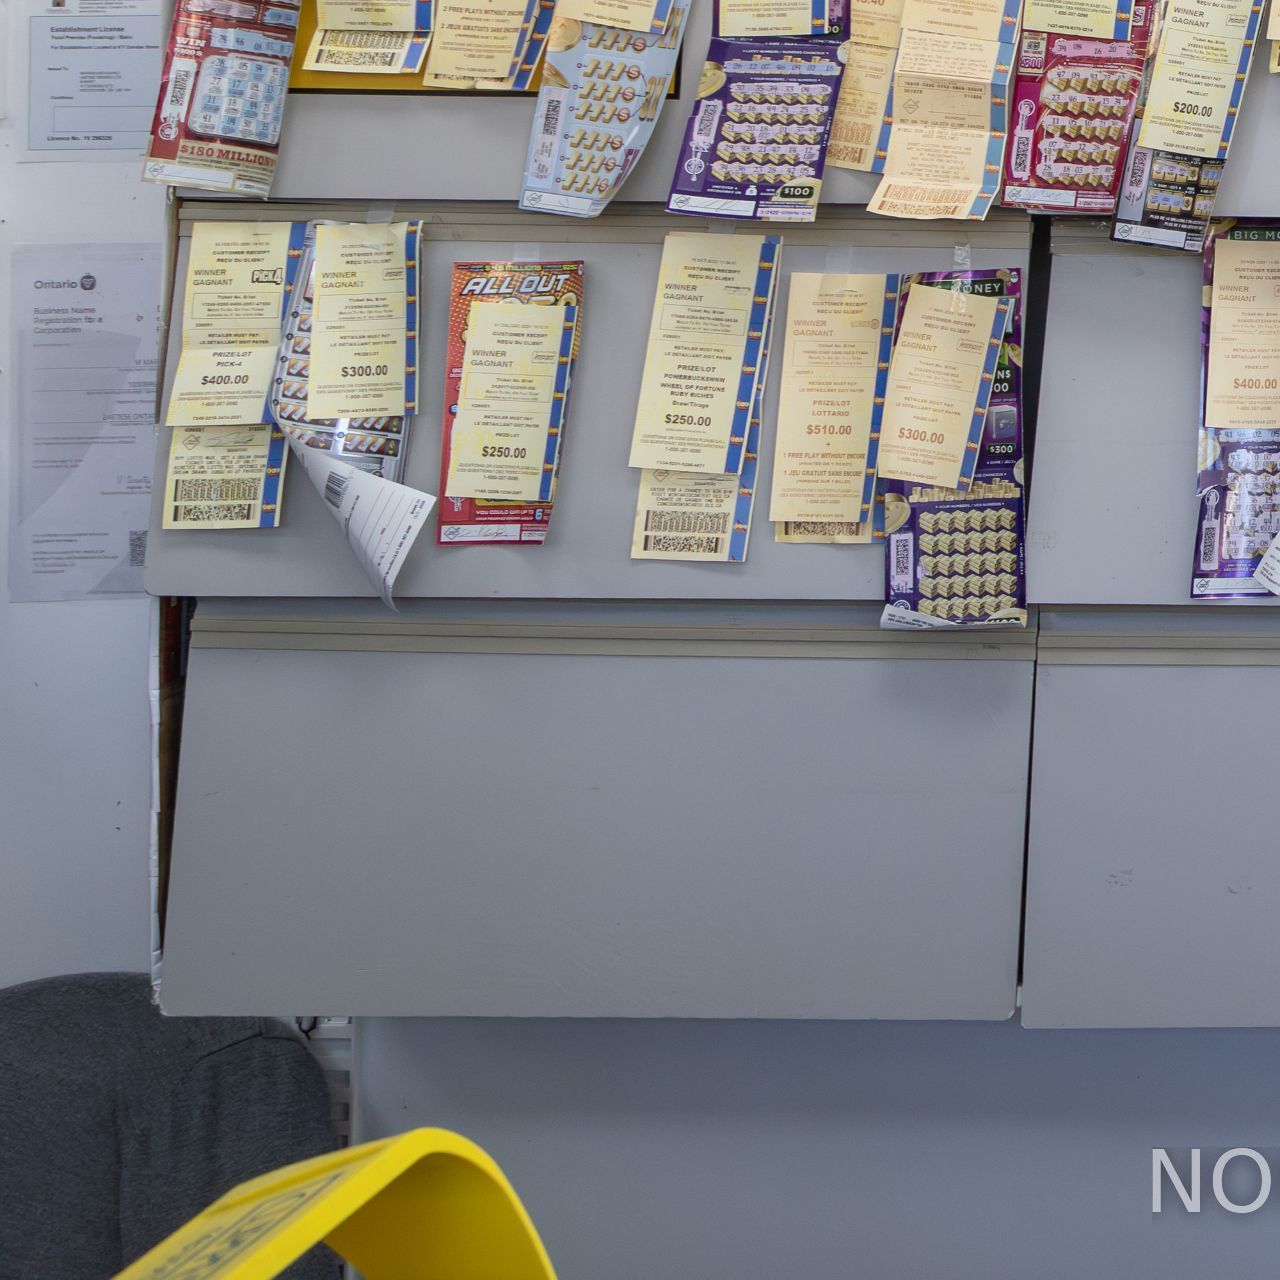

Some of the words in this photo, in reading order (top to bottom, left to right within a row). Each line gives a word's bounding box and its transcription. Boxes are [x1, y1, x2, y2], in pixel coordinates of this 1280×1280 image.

[1173, 102, 1213, 117] $200.00
[1233, 229, 1264, 240] BIG
[461, 275, 510, 296] ALL
[512, 274, 570, 294] OUT
[201, 375, 249, 386] $400.00
[664, 414, 711, 426] $250.00
[806, 424, 852, 436] $510.00
[481, 447, 526, 458] $250.00
